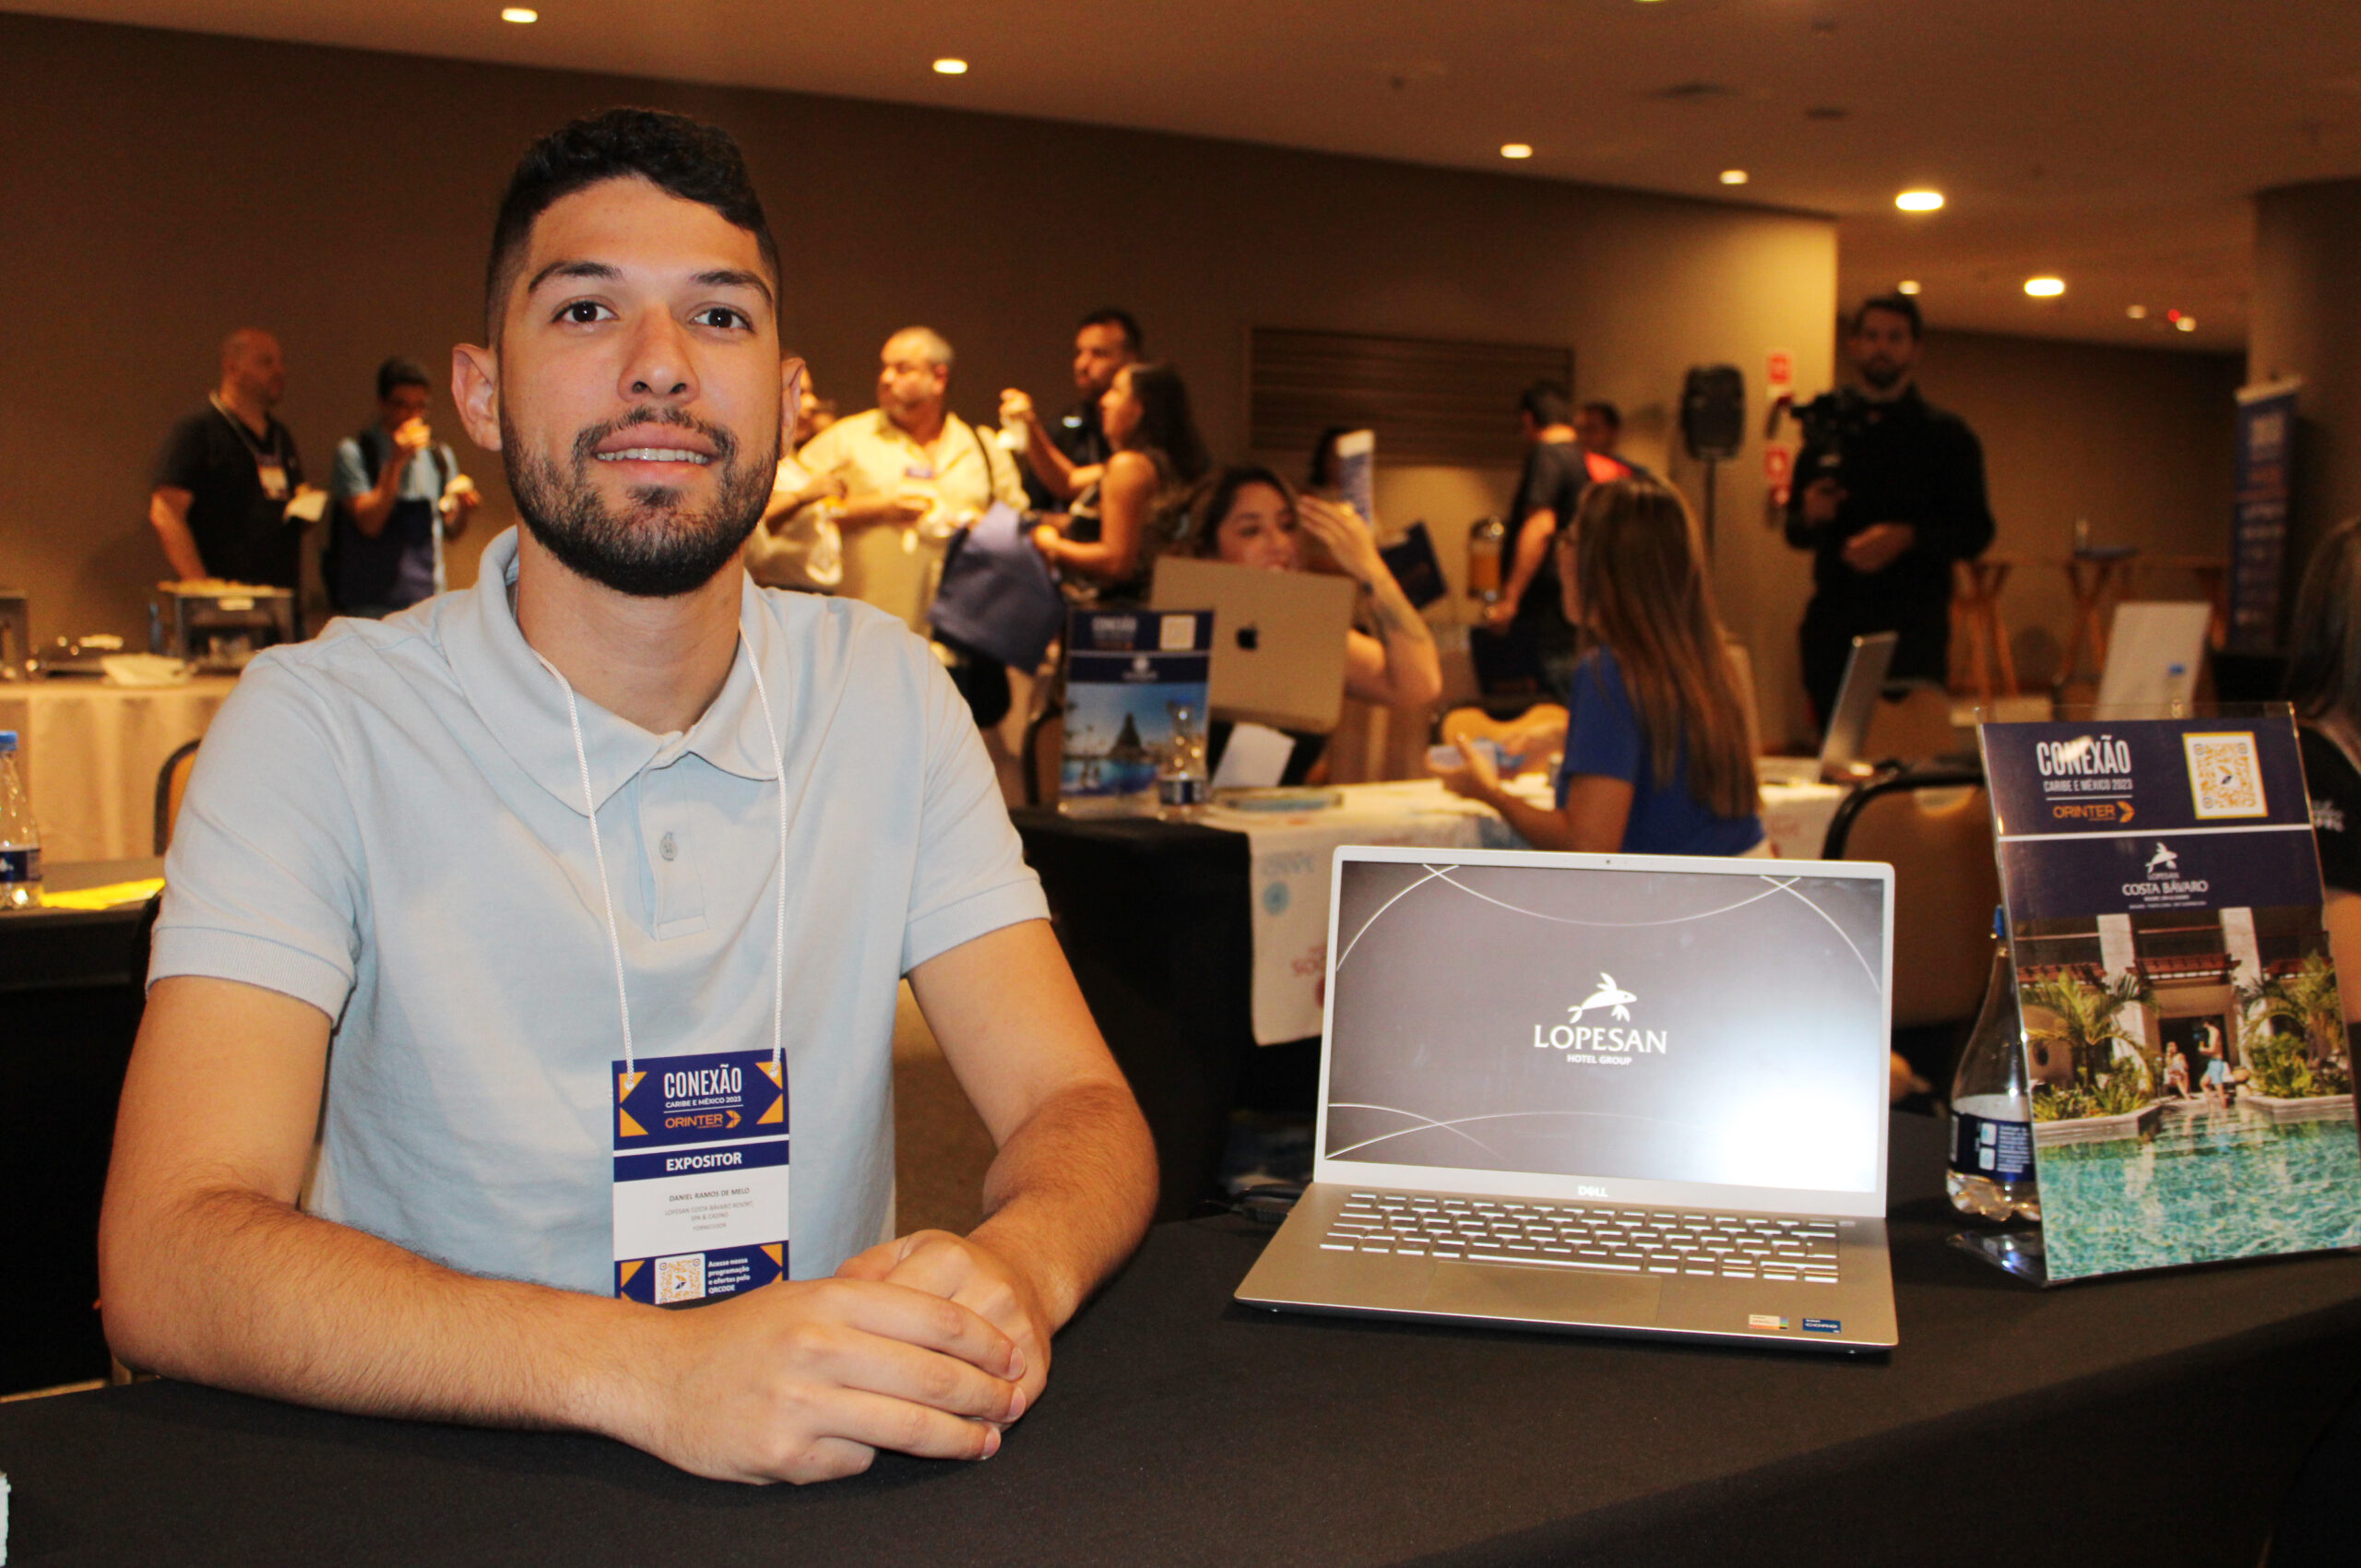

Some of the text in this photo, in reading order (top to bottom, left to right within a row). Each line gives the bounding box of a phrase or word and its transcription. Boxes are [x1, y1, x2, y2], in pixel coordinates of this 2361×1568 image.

[2036, 734, 2131, 776] CONEXÃO
[2053, 804, 2116, 819] ORINTER
[2122, 883, 2161, 896] COSTA
[1534, 1024, 1667, 1054] LOPESAN
[1566, 1053, 1632, 1065] HOTEL GROUP
[664, 1063, 742, 1099] CONEXÃO
[665, 1099, 692, 1109] CARIBE
[698, 1097, 725, 1106] MÉXICO
[726, 1095, 742, 1104] 2023
[665, 1113, 723, 1129] ORINTER
[666, 1152, 742, 1171] EXPOSITOR
[669, 1194, 694, 1202] DANIEL
[694, 1191, 719, 1199] RAMOS
[730, 1187, 751, 1195] MELO
[1578, 1185, 1608, 1197] DELL
